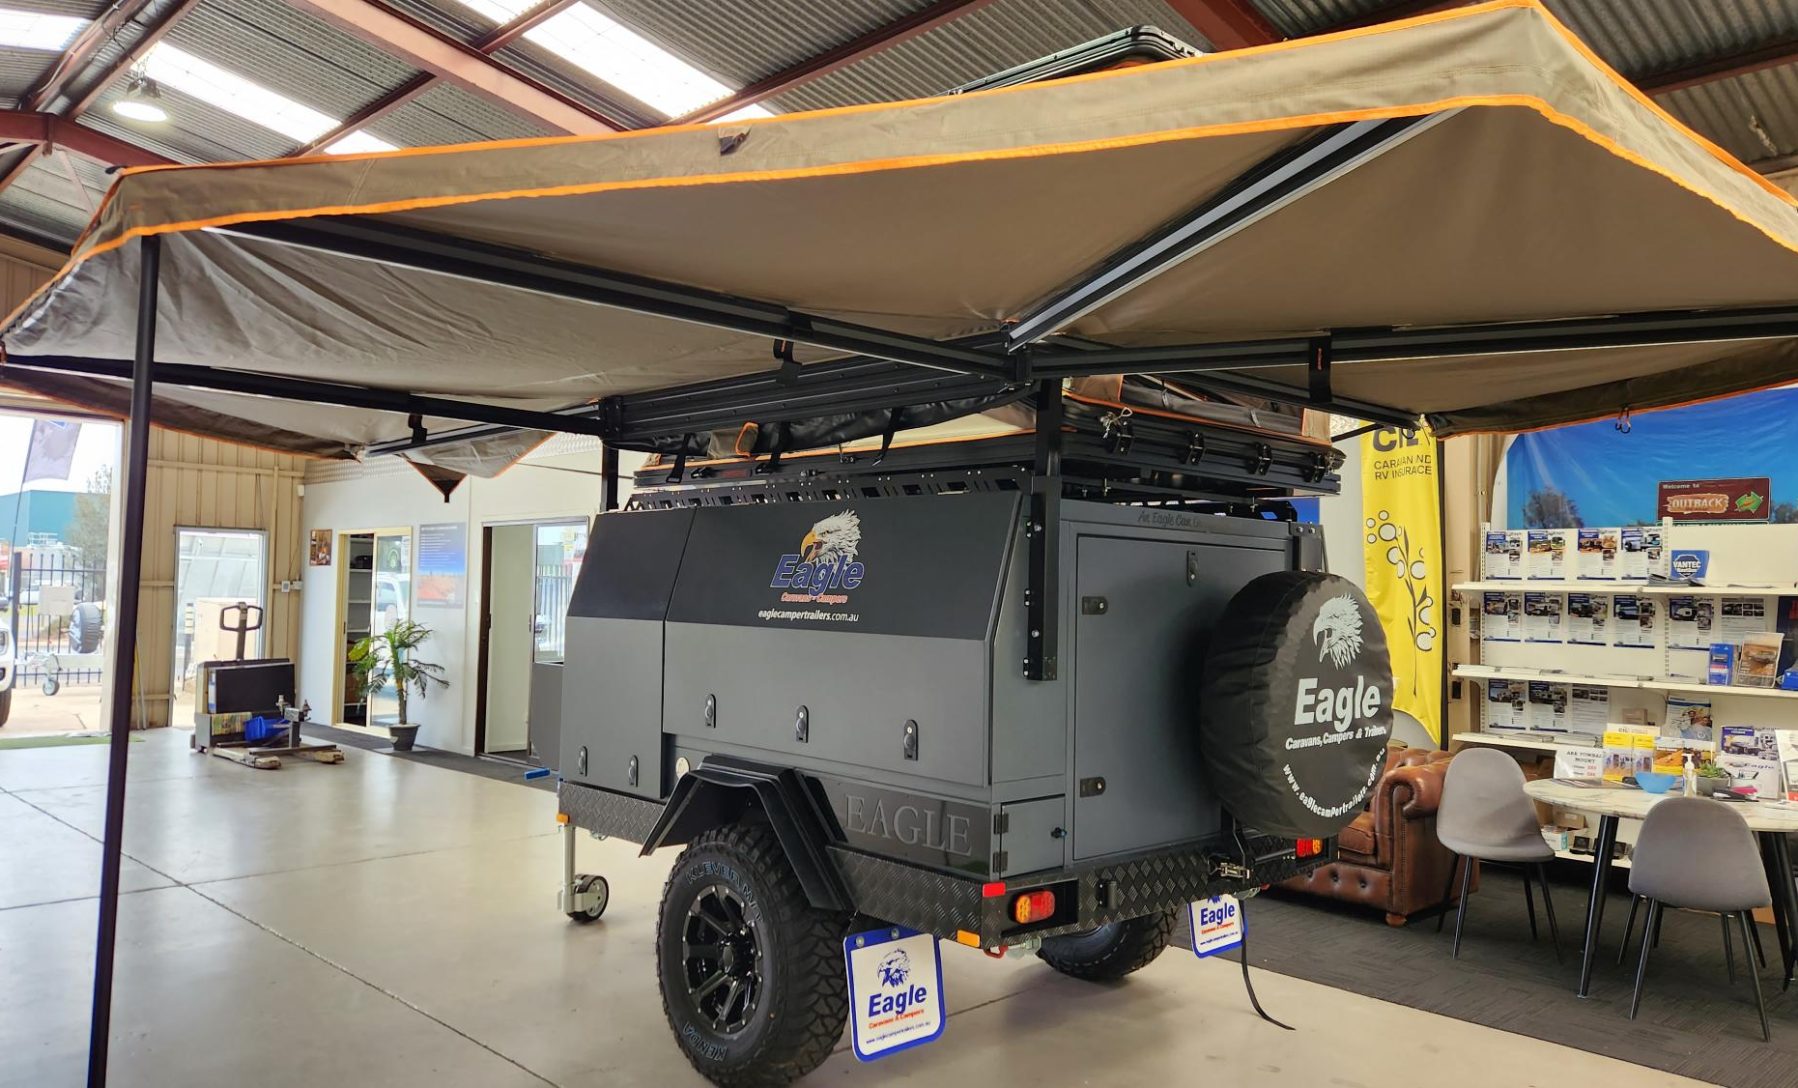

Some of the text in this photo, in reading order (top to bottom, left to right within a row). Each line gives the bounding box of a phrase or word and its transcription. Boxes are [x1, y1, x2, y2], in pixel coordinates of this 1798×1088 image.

[1416, 454, 1432, 464] ND
[1375, 465, 1432, 480] RV INSURACE
[1671, 497, 1724, 509] OUTBACK
[1673, 560, 1701, 569] VANTEC
[770, 553, 865, 598] Eagle
[757, 608, 860, 622] eaglecampertrailers.com.au
[1294, 675, 1382, 733] Eagle
[1323, 730, 1353, 745] Campers
[1355, 728, 1363, 739] &
[845, 794, 972, 857] EAGLE
[686, 861, 741, 890] KLEVER
[1200, 902, 1235, 926] Eagle
[868, 984, 927, 1018] Eagle
[900, 1009, 924, 1019] Campers
[683, 1021, 729, 1062] KENDA
